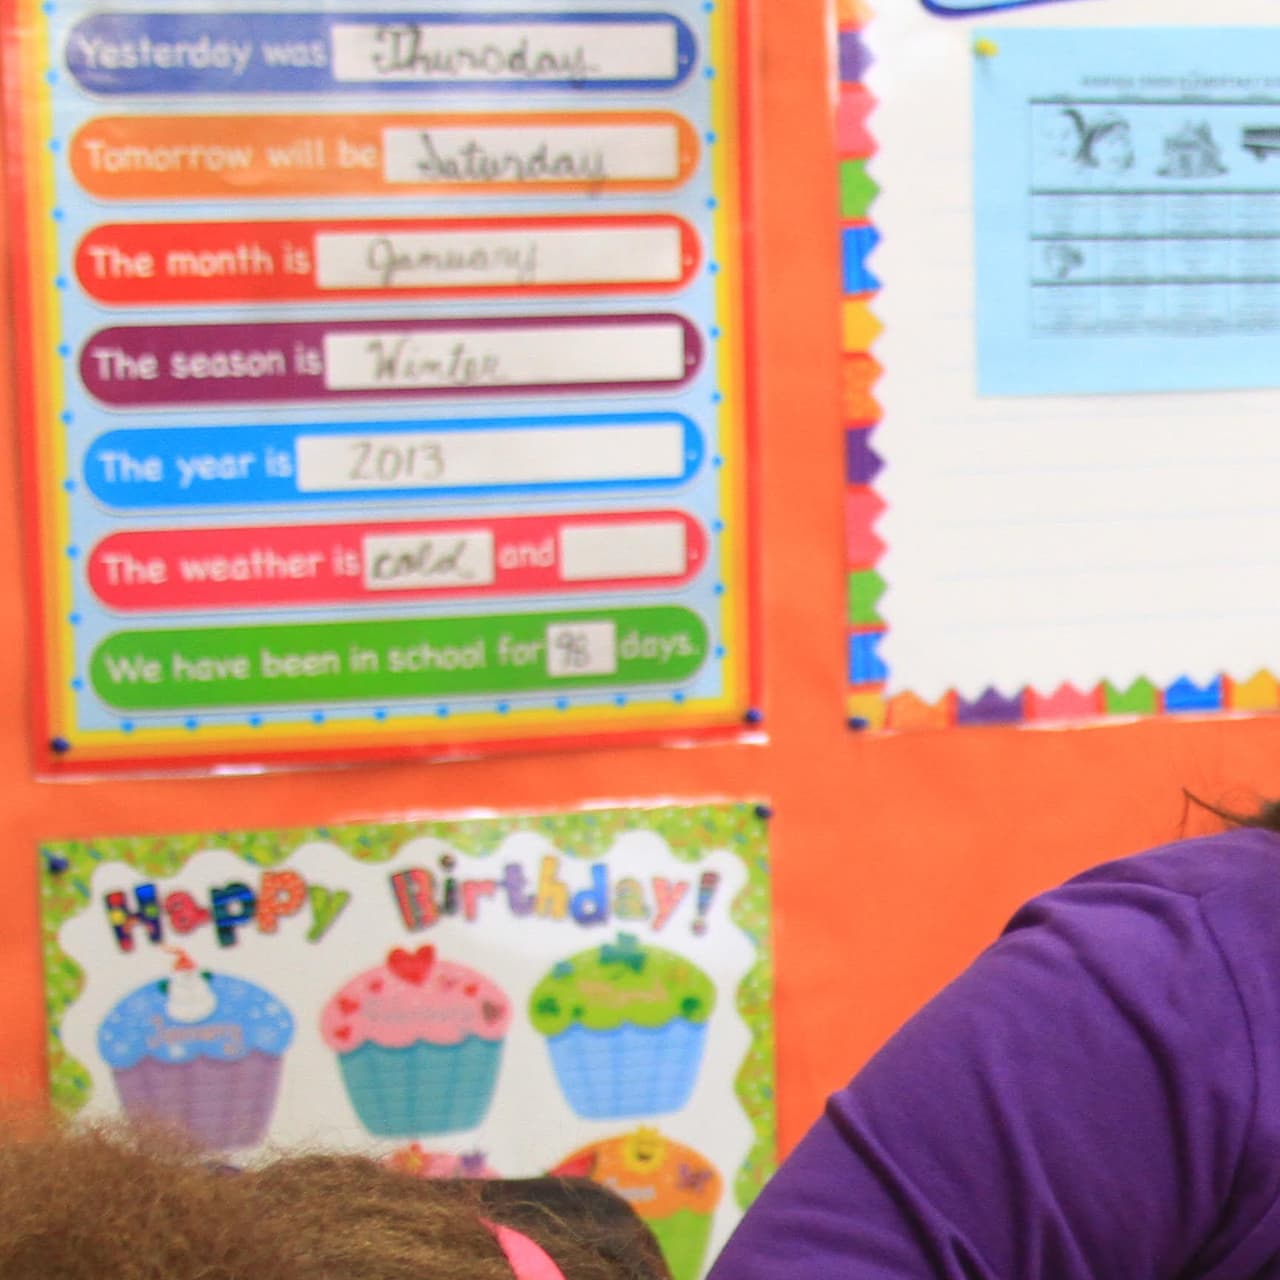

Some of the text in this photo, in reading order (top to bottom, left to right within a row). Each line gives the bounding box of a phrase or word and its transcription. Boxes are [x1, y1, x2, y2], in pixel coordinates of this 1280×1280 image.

[76, 34, 327, 74] Yesterday was
[370, 24, 600, 86] Thursday
[84, 137, 378, 172] Tomorrow will be
[417, 132, 608, 192] Saturday
[91, 239, 310, 277] The month is
[94, 346, 322, 380] The season is
[368, 338, 502, 384] Winter
[100, 447, 292, 486] The year is
[348, 441, 447, 482] 2013
[103, 549, 360, 585] The weather is
[369, 540, 470, 582] cold
[500, 539, 556, 569] and
[106, 636, 547, 686] We have been in school for
[619, 629, 699, 664] days.
[102, 852, 722, 952] Happy Birthday!
